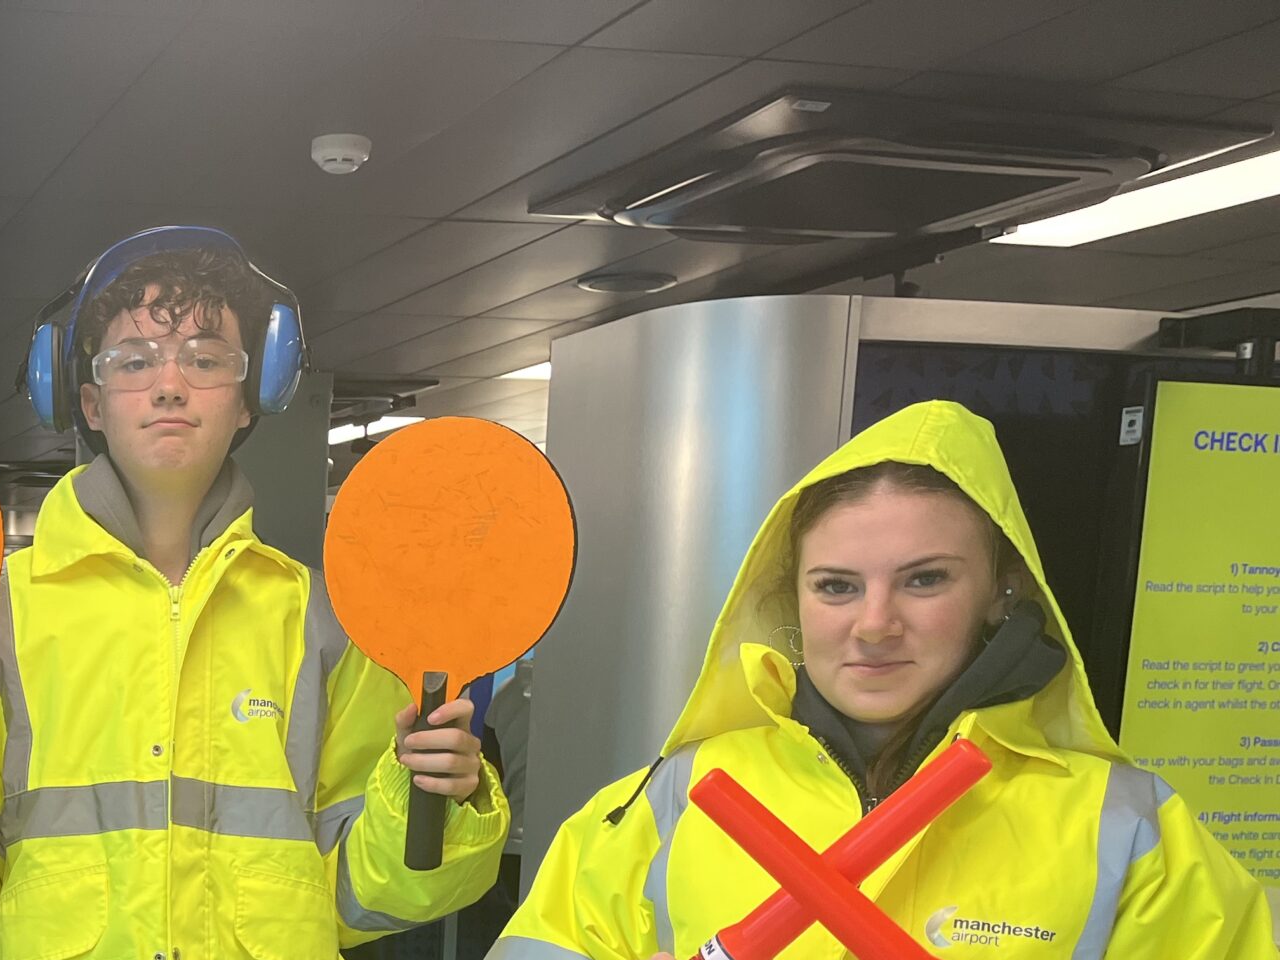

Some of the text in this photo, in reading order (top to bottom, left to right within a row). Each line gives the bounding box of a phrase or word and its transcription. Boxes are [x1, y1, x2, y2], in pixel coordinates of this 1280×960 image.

[1194, 430, 1268, 454] CHECK
[1242, 563, 1280, 578] Tannoy
[1145, 580, 1173, 592] Read
[1176, 581, 1193, 593] the
[1196, 583, 1226, 595] script
[1228, 584, 1239, 594] to
[1241, 584, 1264, 596] help
[1242, 604, 1278, 616] to your
[1258, 641, 1269, 655] 2)
[1142, 659, 1170, 671] Read
[1173, 659, 1189, 671] the
[1192, 660, 1222, 673] script
[1225, 661, 1235, 671] to
[1238, 661, 1265, 674] greet
[1147, 679, 1179, 690] check
[1182, 680, 1191, 690] in
[1195, 679, 1209, 690] for
[1212, 680, 1235, 690] their
[1137, 699, 1169, 709] check
[1173, 700, 1182, 709] in
[1185, 700, 1216, 712] agent
[1218, 699, 1248, 710] whilst
[1250, 699, 1268, 710] the
[1239, 736, 1251, 749] 3)
[1152, 758, 1165, 769] up
[1168, 756, 1190, 766] with
[1193, 757, 1216, 768] your
[1219, 756, 1244, 768] bags
[1247, 755, 1267, 767] and
[1209, 775, 1225, 785] the
[1228, 774, 1261, 785] Check
[1212, 811, 1242, 825] Flight
[1232, 831, 1259, 841] white
[1248, 848, 1273, 861] flight
[952, 917, 1057, 943] manchester
[951, 931, 1000, 948] airport
